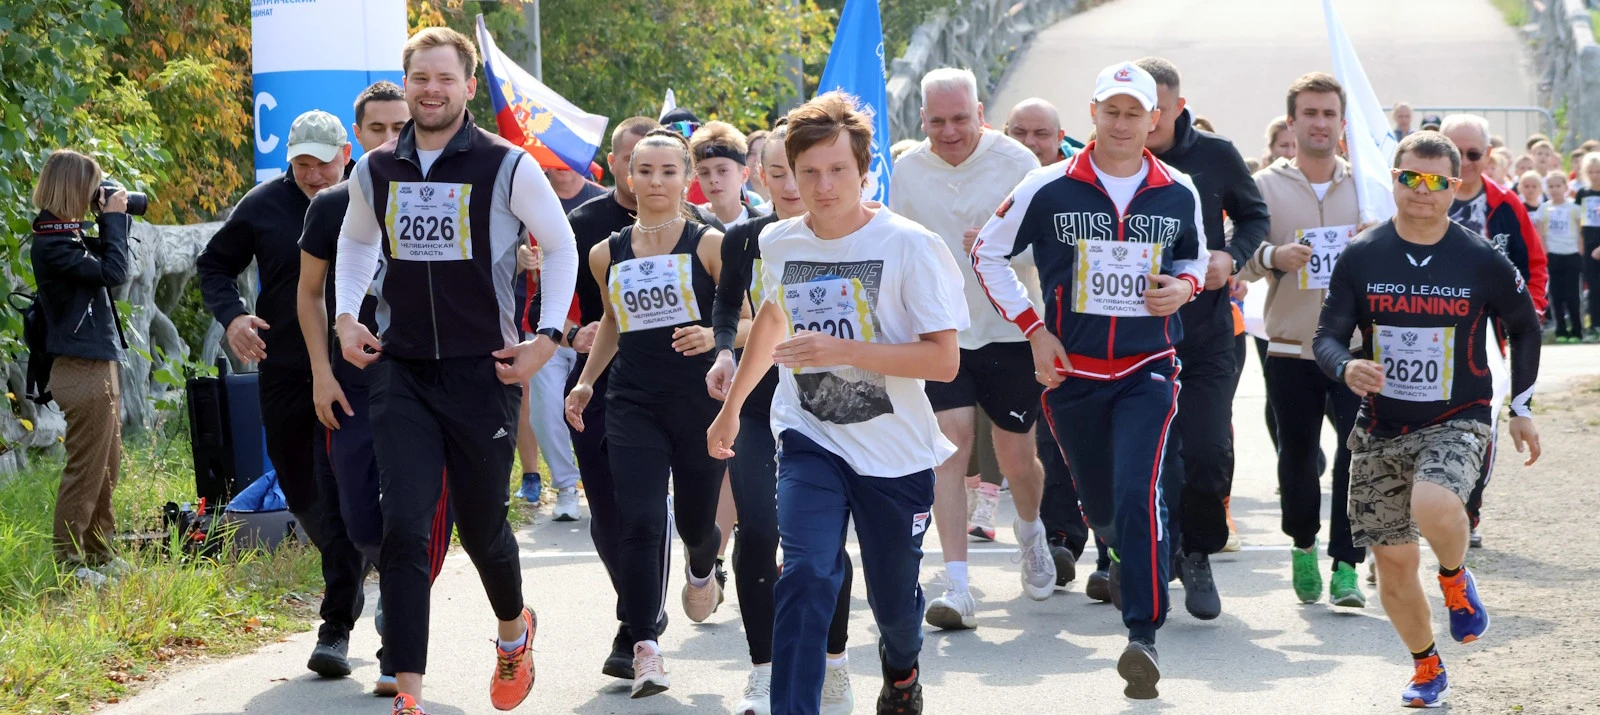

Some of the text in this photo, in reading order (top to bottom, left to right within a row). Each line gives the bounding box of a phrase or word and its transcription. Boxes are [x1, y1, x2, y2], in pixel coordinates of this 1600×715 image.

[399, 215, 454, 241] 2626
[1092, 272, 1146, 298] 9090
[1366, 283, 1471, 298] HERO LEAGUE
[623, 284, 678, 313] 9696
[1366, 295, 1471, 316] TRAINING
[633, 307, 683, 319] ЧЕЛЯБИНСКАЯ
[642, 315, 675, 325] ОБЛАСТЬ
[1384, 357, 1438, 383] 2620
[1393, 389, 1428, 397] ОБЛАСТЬ
